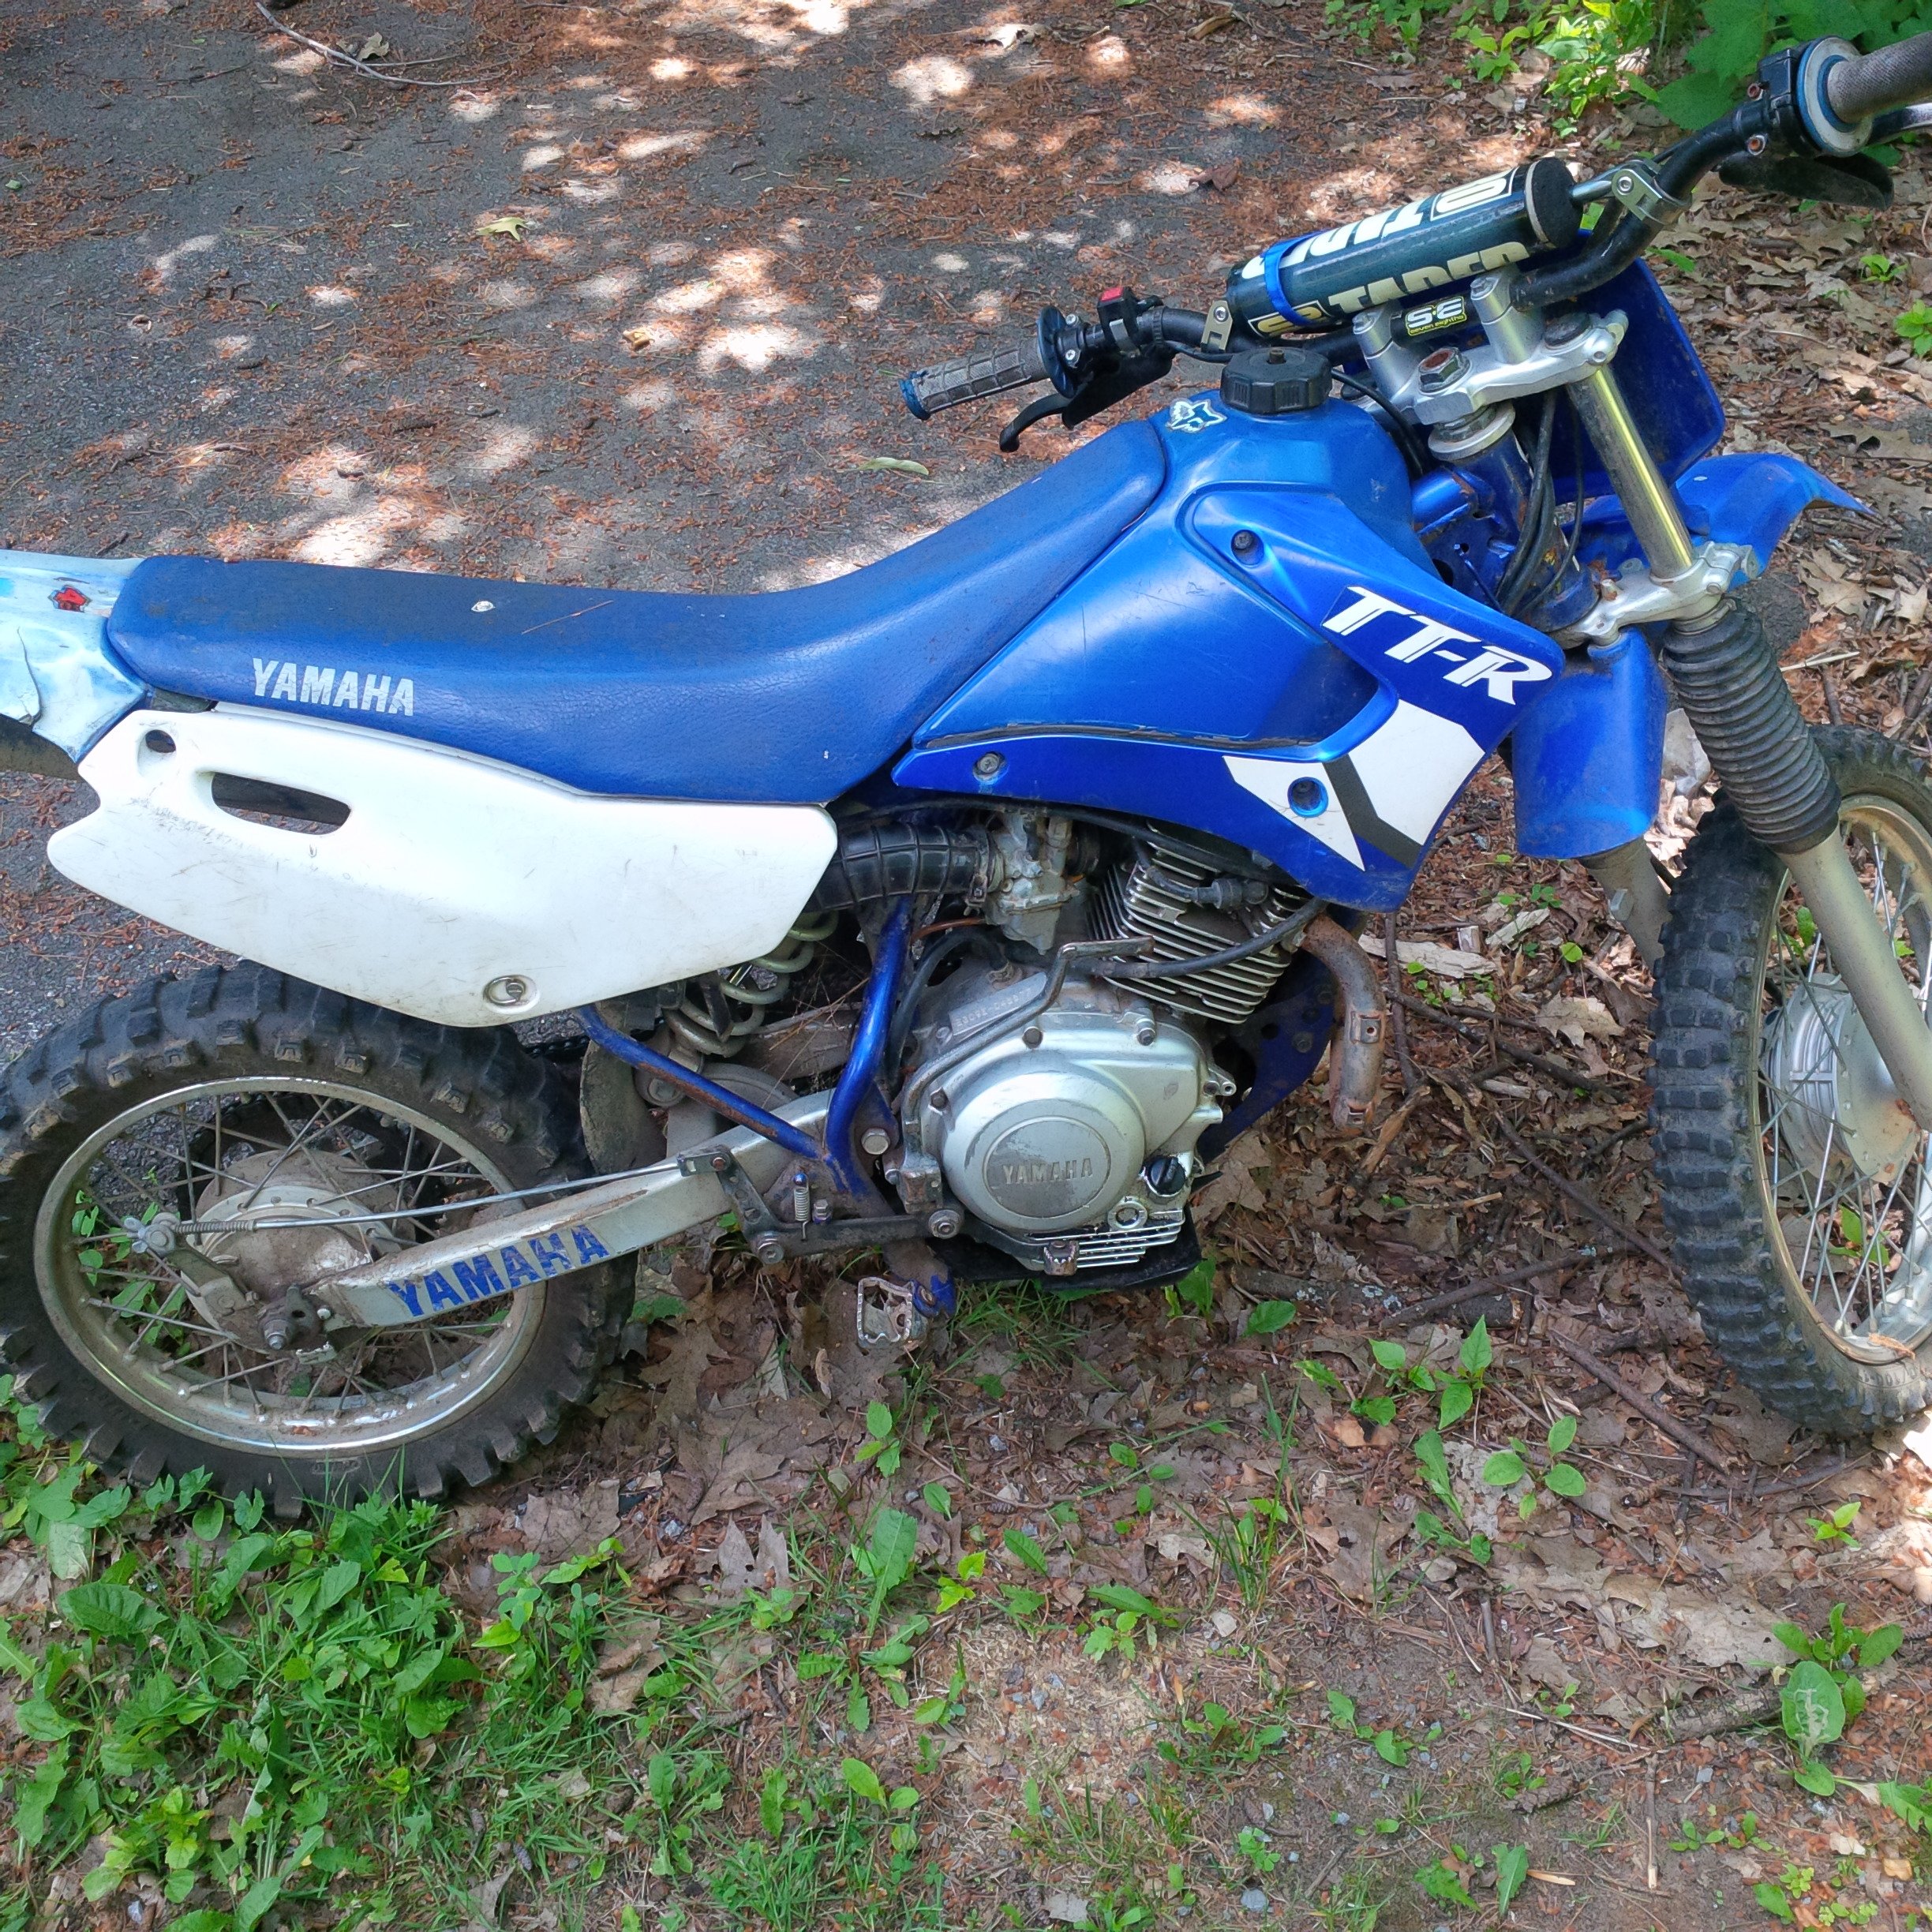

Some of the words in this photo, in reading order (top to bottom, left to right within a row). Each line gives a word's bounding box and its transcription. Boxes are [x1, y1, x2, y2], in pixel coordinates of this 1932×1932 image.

[1322, 586, 1552, 705] TT-R
[253, 657, 414, 716] YAMAHA
[1003, 1158, 1093, 1185] YAMAHA
[388, 1225, 610, 1317] YAMAHA
